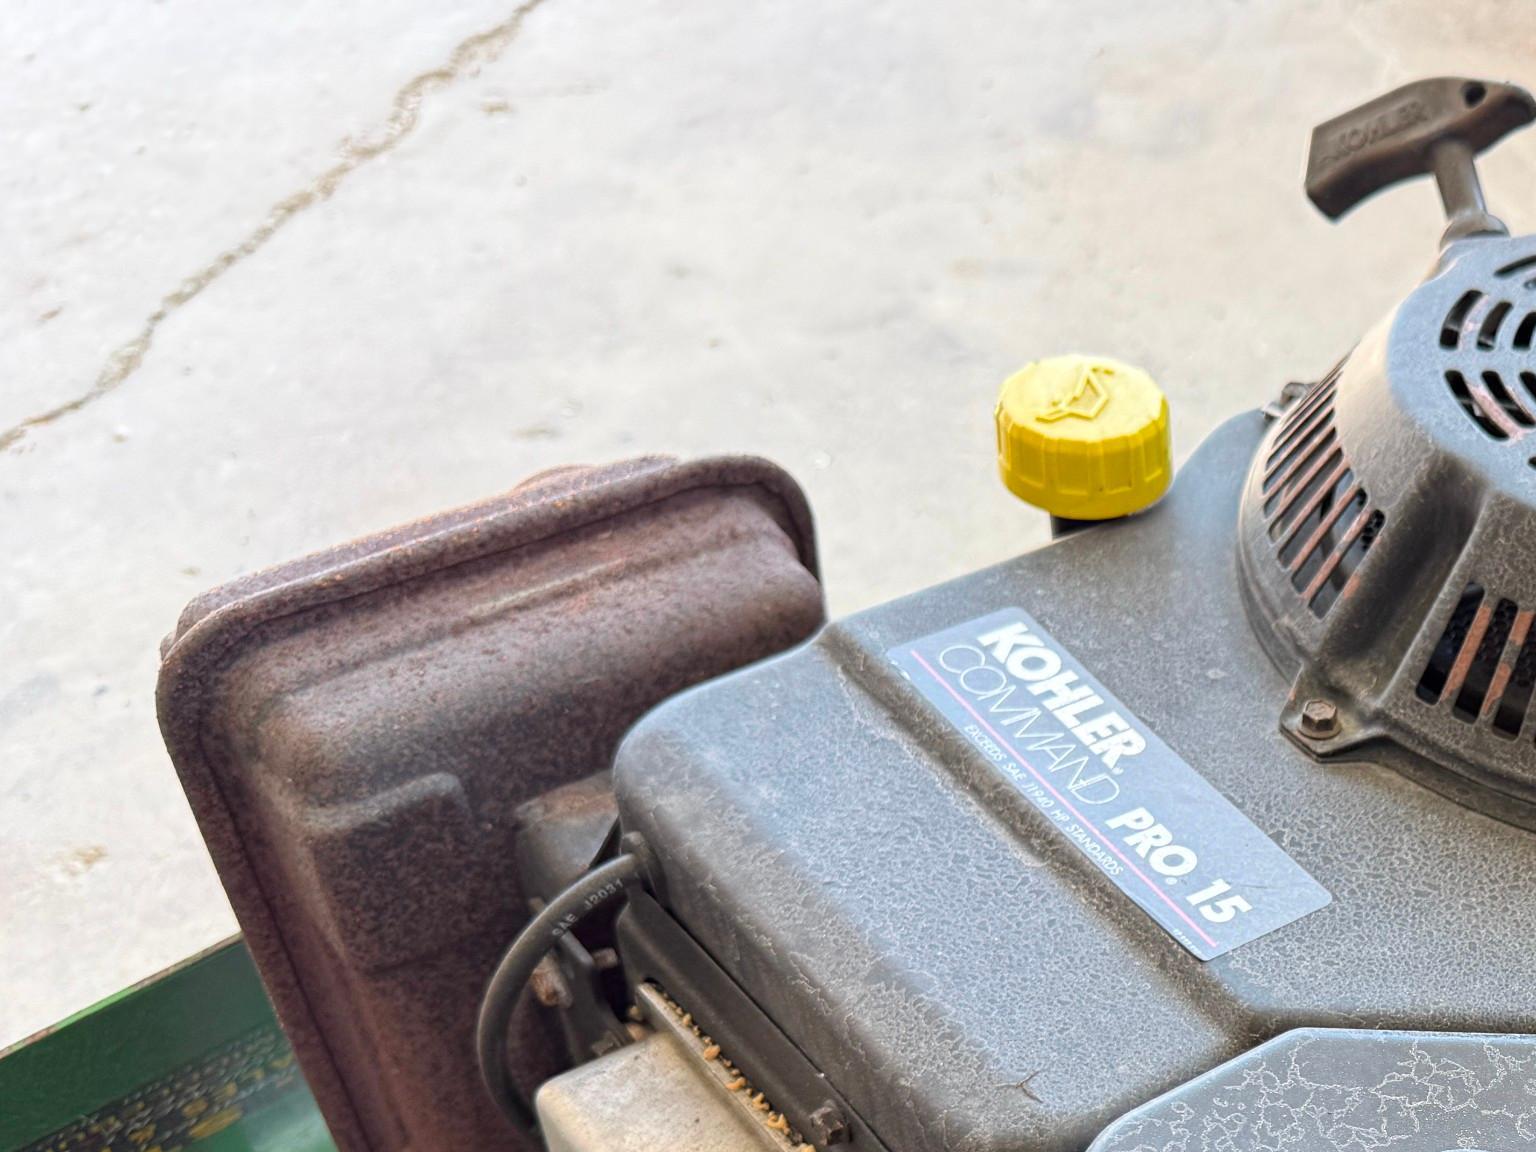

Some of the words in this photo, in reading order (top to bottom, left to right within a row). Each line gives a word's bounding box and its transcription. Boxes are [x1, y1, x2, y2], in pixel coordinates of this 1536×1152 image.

[977, 622, 1146, 771] KOHLER
[939, 644, 1120, 805] COMMAND
[1185, 870, 1254, 924] 15
[964, 724, 1008, 763] EXCEEDS
[1002, 762, 1028, 783] SAE
[1065, 822, 1125, 876] STANDARDS
